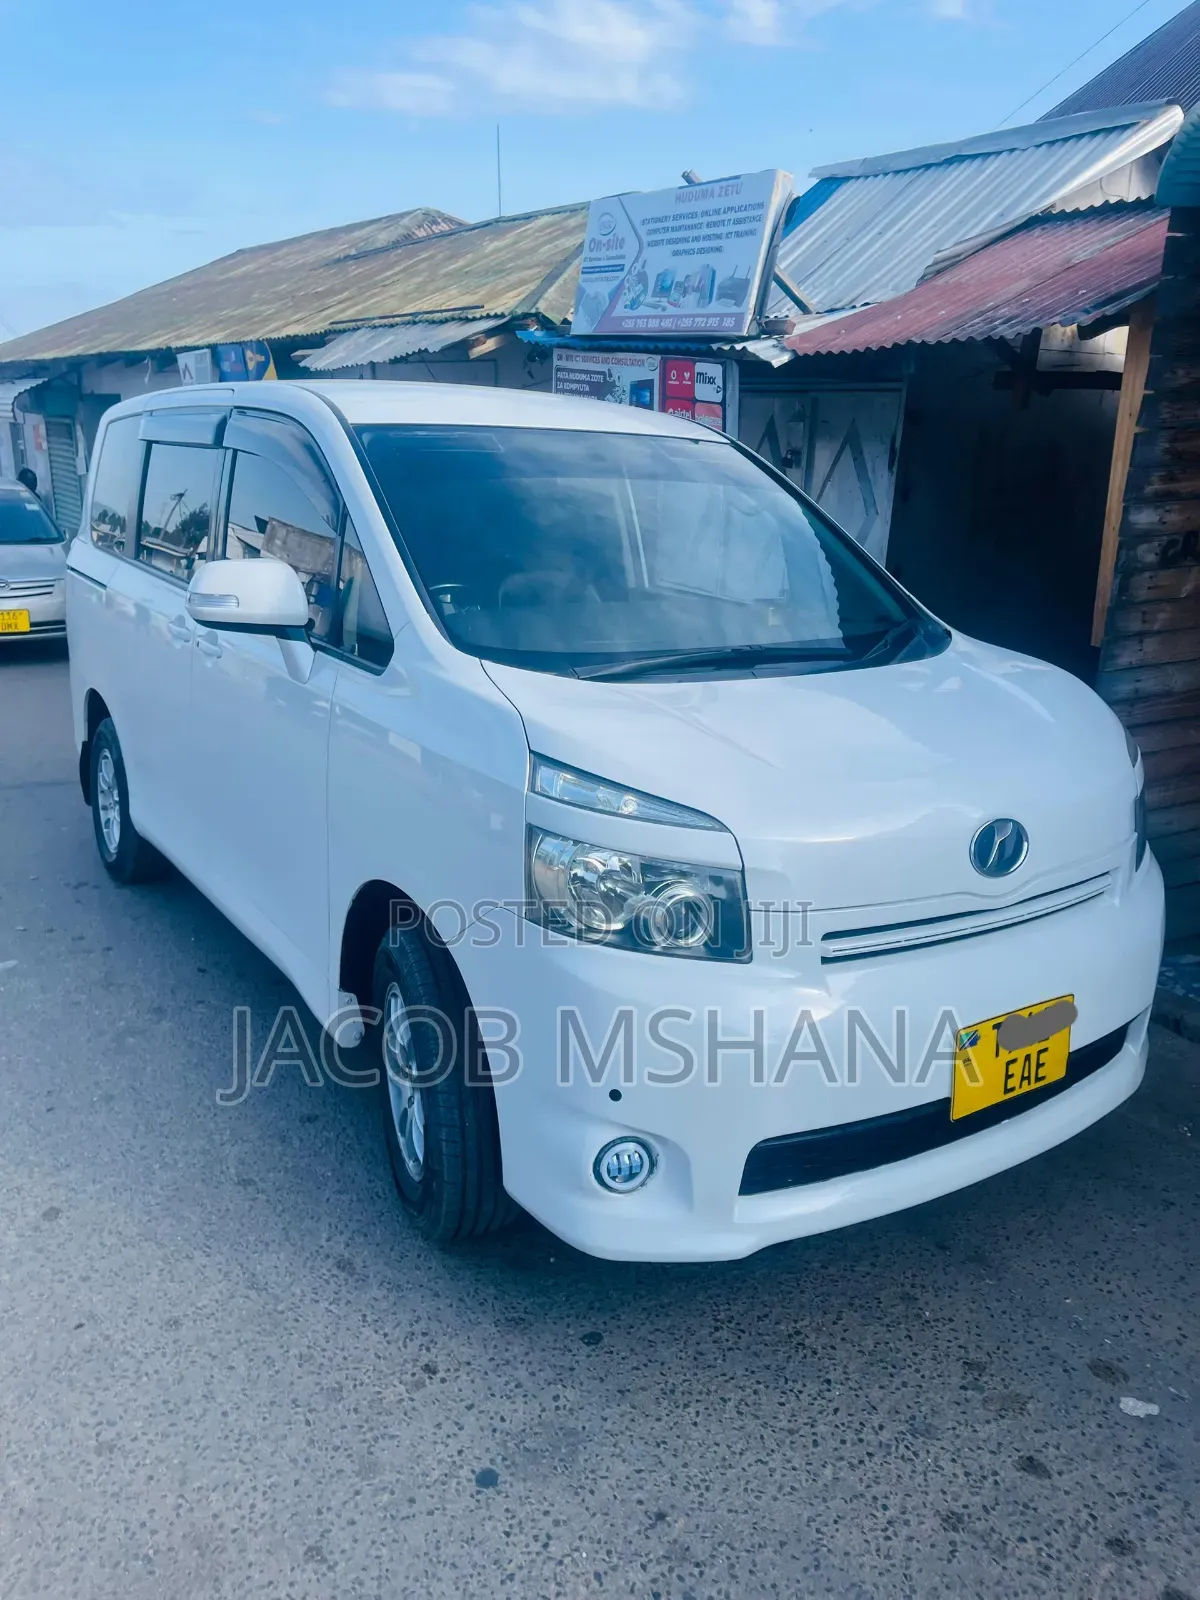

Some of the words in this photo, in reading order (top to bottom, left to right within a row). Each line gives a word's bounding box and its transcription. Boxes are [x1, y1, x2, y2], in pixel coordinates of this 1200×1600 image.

[675, 188, 715, 204] HUDUMA
[717, 182, 743, 198] ZETU
[641, 215, 671, 226] STATIONERY
[671, 211, 699, 222] SERVICES
[700, 207, 722, 218] ONLINE
[722, 202, 765, 214] APPLICATIONS
[705, 219, 726, 229] REMOTE
[588, 232, 626, 252] On-site
[691, 234, 701, 243] AND
[701, 232, 723, 242] HOSTING
[733, 228, 757, 239] TRAINING
[671, 247, 696, 257] GRAPHICS
[696, 245, 723, 255] DESIGNING
[581, 354, 600, 364] SERVICES
[600, 356, 611, 365] AND
[557, 371, 569, 379] PATA
[569, 372, 591, 382] HUDUMA
[1003, 1047, 1049, 1095] EAE
